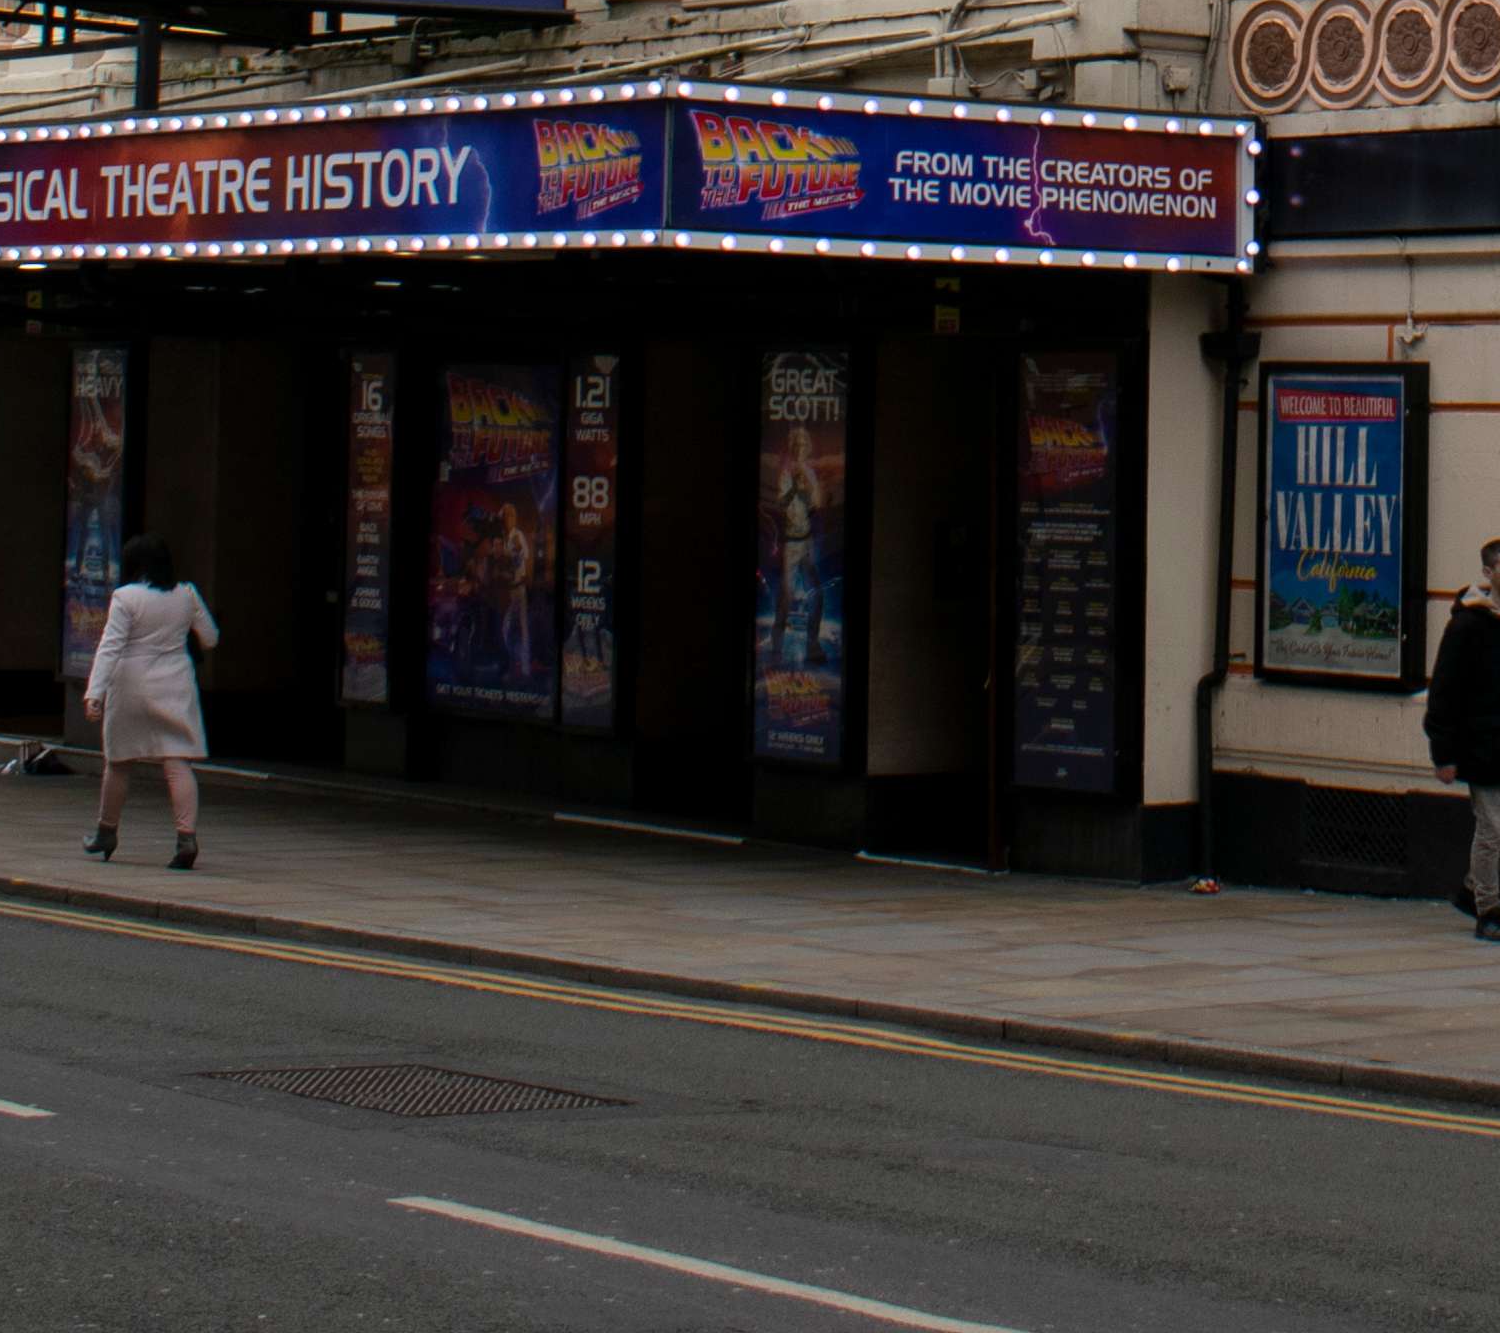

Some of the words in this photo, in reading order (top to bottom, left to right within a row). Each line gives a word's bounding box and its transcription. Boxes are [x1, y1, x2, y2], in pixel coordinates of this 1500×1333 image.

[533, 118, 620, 167] BACK
[689, 109, 828, 164] BACK
[100, 157, 272, 218] THEATRE
[285, 145, 473, 213] HISTORY
[560, 155, 643, 208] FUTURE
[702, 163, 735, 185] TO
[736, 160, 863, 202] FUTURE
[895, 150, 974, 177] FROM
[982, 155, 1031, 181] THE
[1040, 159, 1171, 190] CREATORS
[1179, 167, 1213, 192] OF
[700, 185, 739, 210] THE
[787, 200, 809, 213] THE
[812, 191, 858, 209] MUSICAL
[888, 177, 940, 204] THE
[949, 181, 1032, 209] MOVIE
[1041, 186, 1217, 219] PHENOMENON
[74, 375, 124, 398] HEAVY
[362, 380, 384, 411] 16
[575, 374, 611, 408] 1.21
[771, 368, 838, 394] GREAT
[446, 371, 532, 426] BACK
[769, 395, 840, 421] SCOTT!
[1280, 394, 1327, 415] WELCOME
[1329, 396, 1341, 415] TO
[1343, 396, 1396, 418] BEAUTIFUL
[574, 428, 610, 442] WATTS
[580, 412, 604, 425] GIGA
[1295, 424, 1378, 487] HILL
[572, 475, 609, 509] 88
[579, 511, 602, 526] MPH
[1275, 489, 1397, 557] VALLEY
[577, 559, 601, 594] 12
[1296, 547, 1378, 593] California
[571, 596, 606, 612] WEEKS
